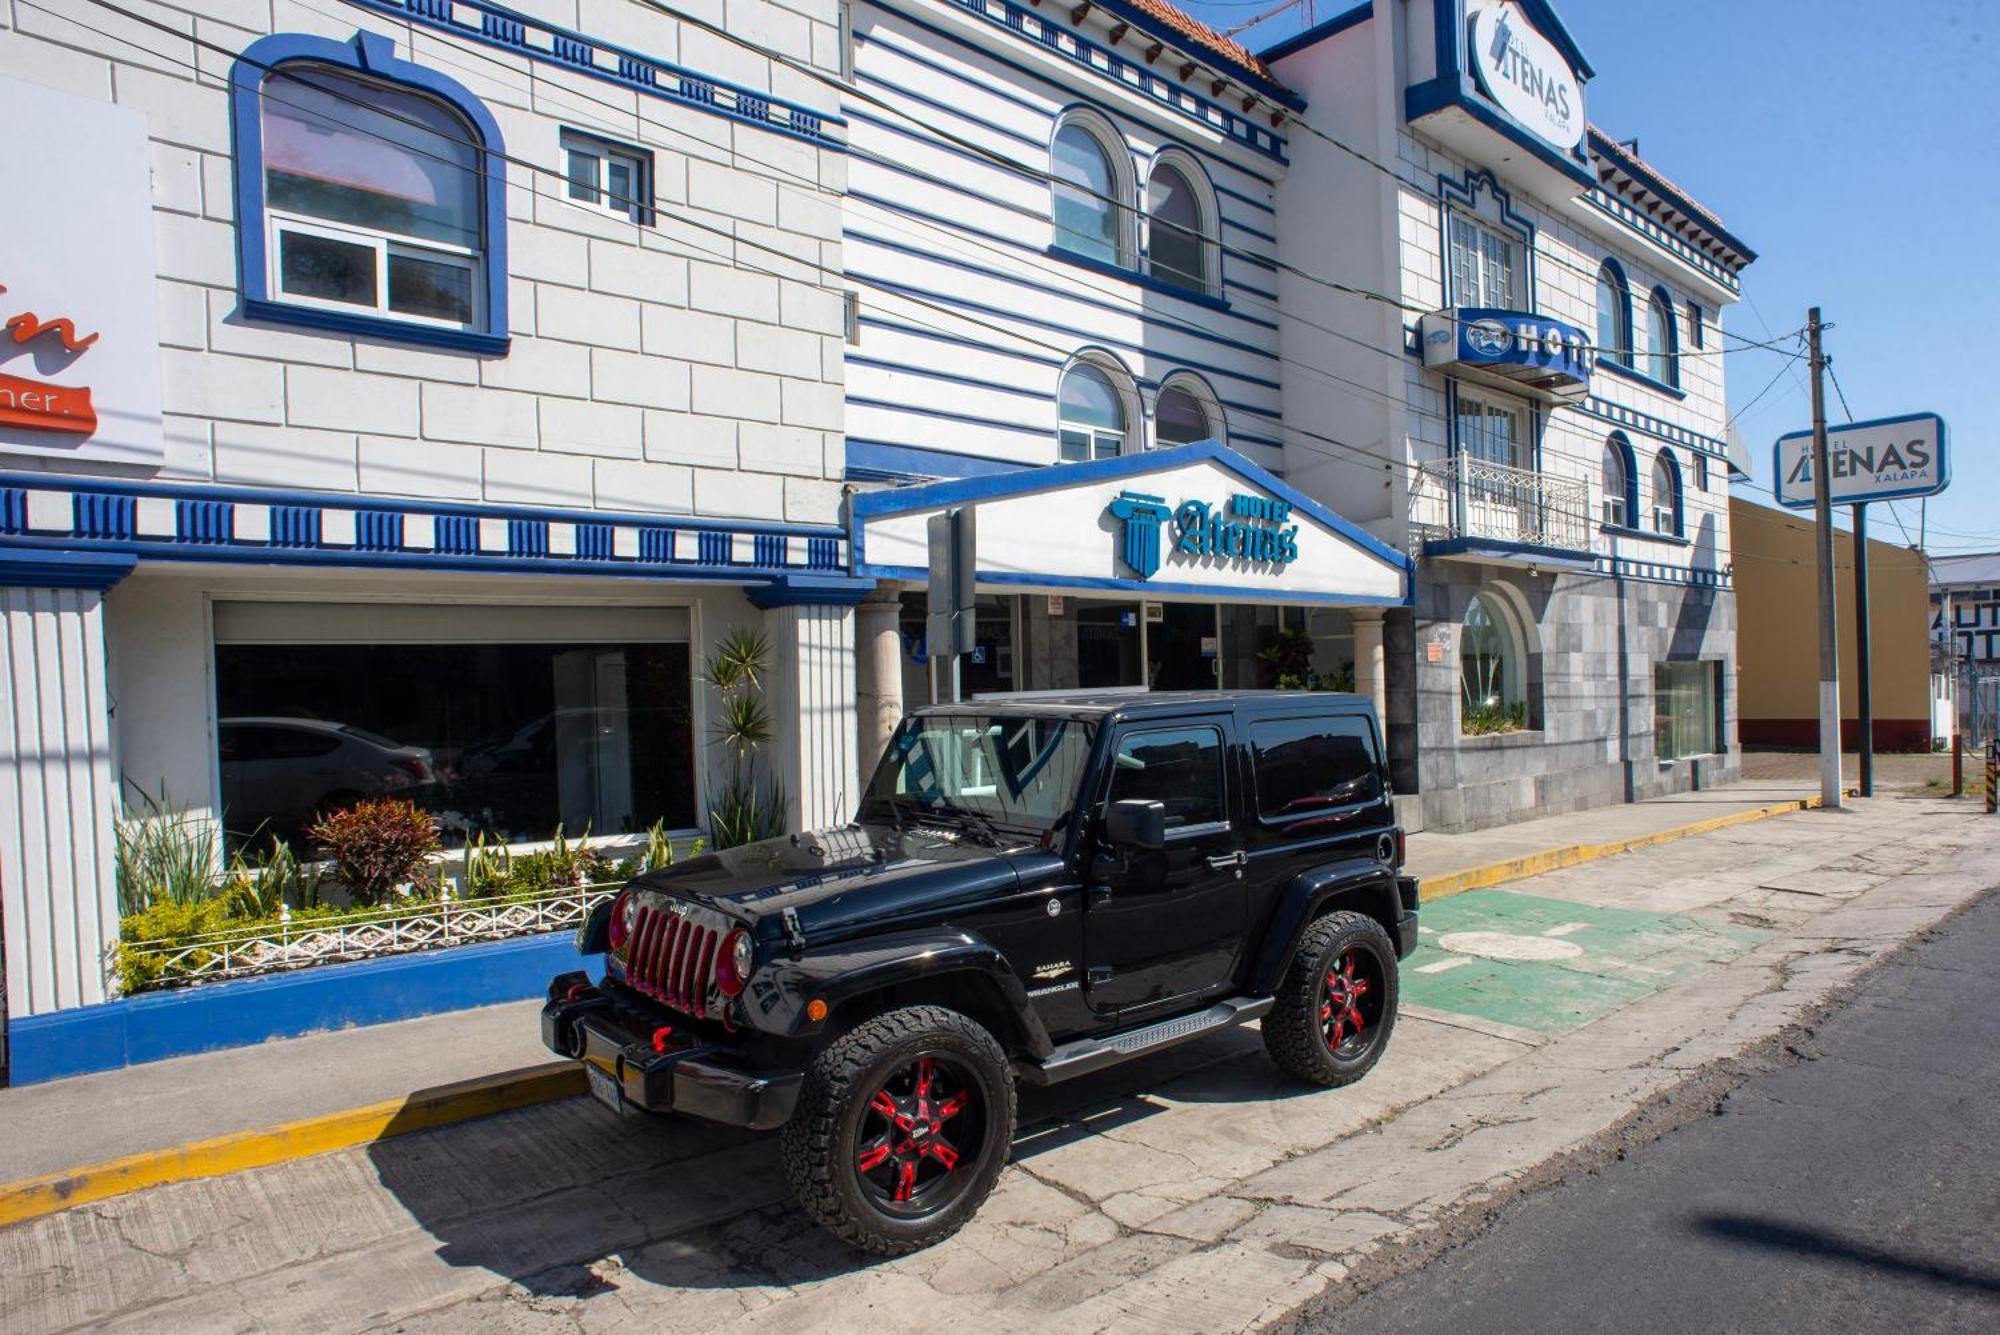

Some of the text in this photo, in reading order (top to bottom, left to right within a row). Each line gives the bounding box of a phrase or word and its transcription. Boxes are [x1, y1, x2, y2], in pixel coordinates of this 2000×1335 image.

[1801, 439, 1848, 454] HEL
[1787, 438, 1931, 484] AENAS
[1874, 469, 1928, 484] XALAPA
[1232, 494, 1292, 522] HOTEL
[1176, 499, 1299, 564] Atenas
[1035, 960, 1071, 972] SAHARA
[1026, 981, 1080, 998] WRANGLER
